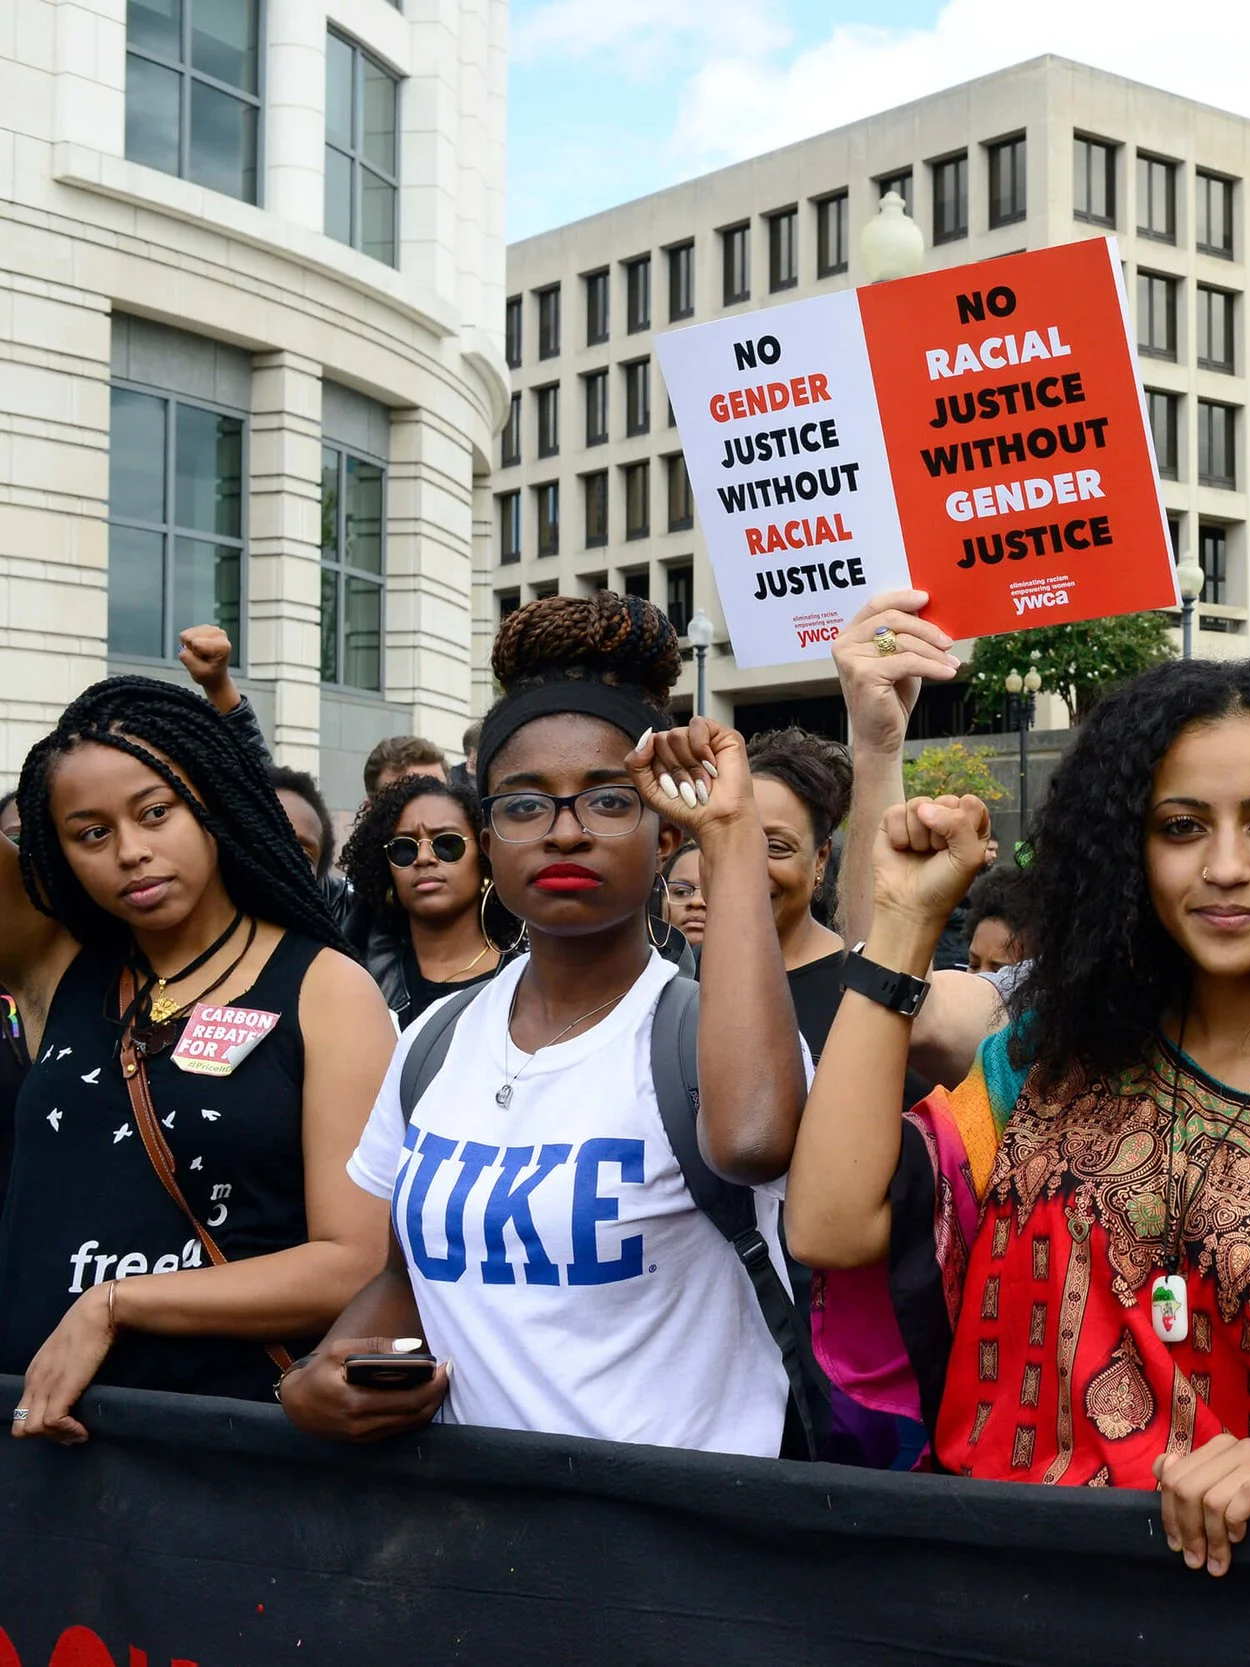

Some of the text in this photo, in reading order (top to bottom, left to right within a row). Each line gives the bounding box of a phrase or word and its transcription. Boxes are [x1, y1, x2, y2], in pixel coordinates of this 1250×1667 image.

[956, 286, 1016, 324] NO
[733, 335, 781, 371] NO
[925, 326, 1072, 381] RACIAL
[709, 372, 833, 423] GENDER
[929, 372, 1086, 429] JUSTICE
[720, 419, 840, 468] JUSTICE
[920, 418, 1109, 478] WITHOUT
[716, 462, 860, 514] WITHOUT
[945, 469, 1106, 522] GENDER
[745, 513, 853, 556] RACIAL
[956, 515, 1114, 569] JUSTICE
[753, 557, 866, 601] JUSTICE
[1009, 575, 1069, 589] eliminating racism
[1011, 581, 1076, 596] empowering women
[1012, 590, 1069, 616] ywca
[797, 626, 839, 648] ywca
[201, 1008, 273, 1029] CARBON
[178, 1039, 218, 1057] FOR
